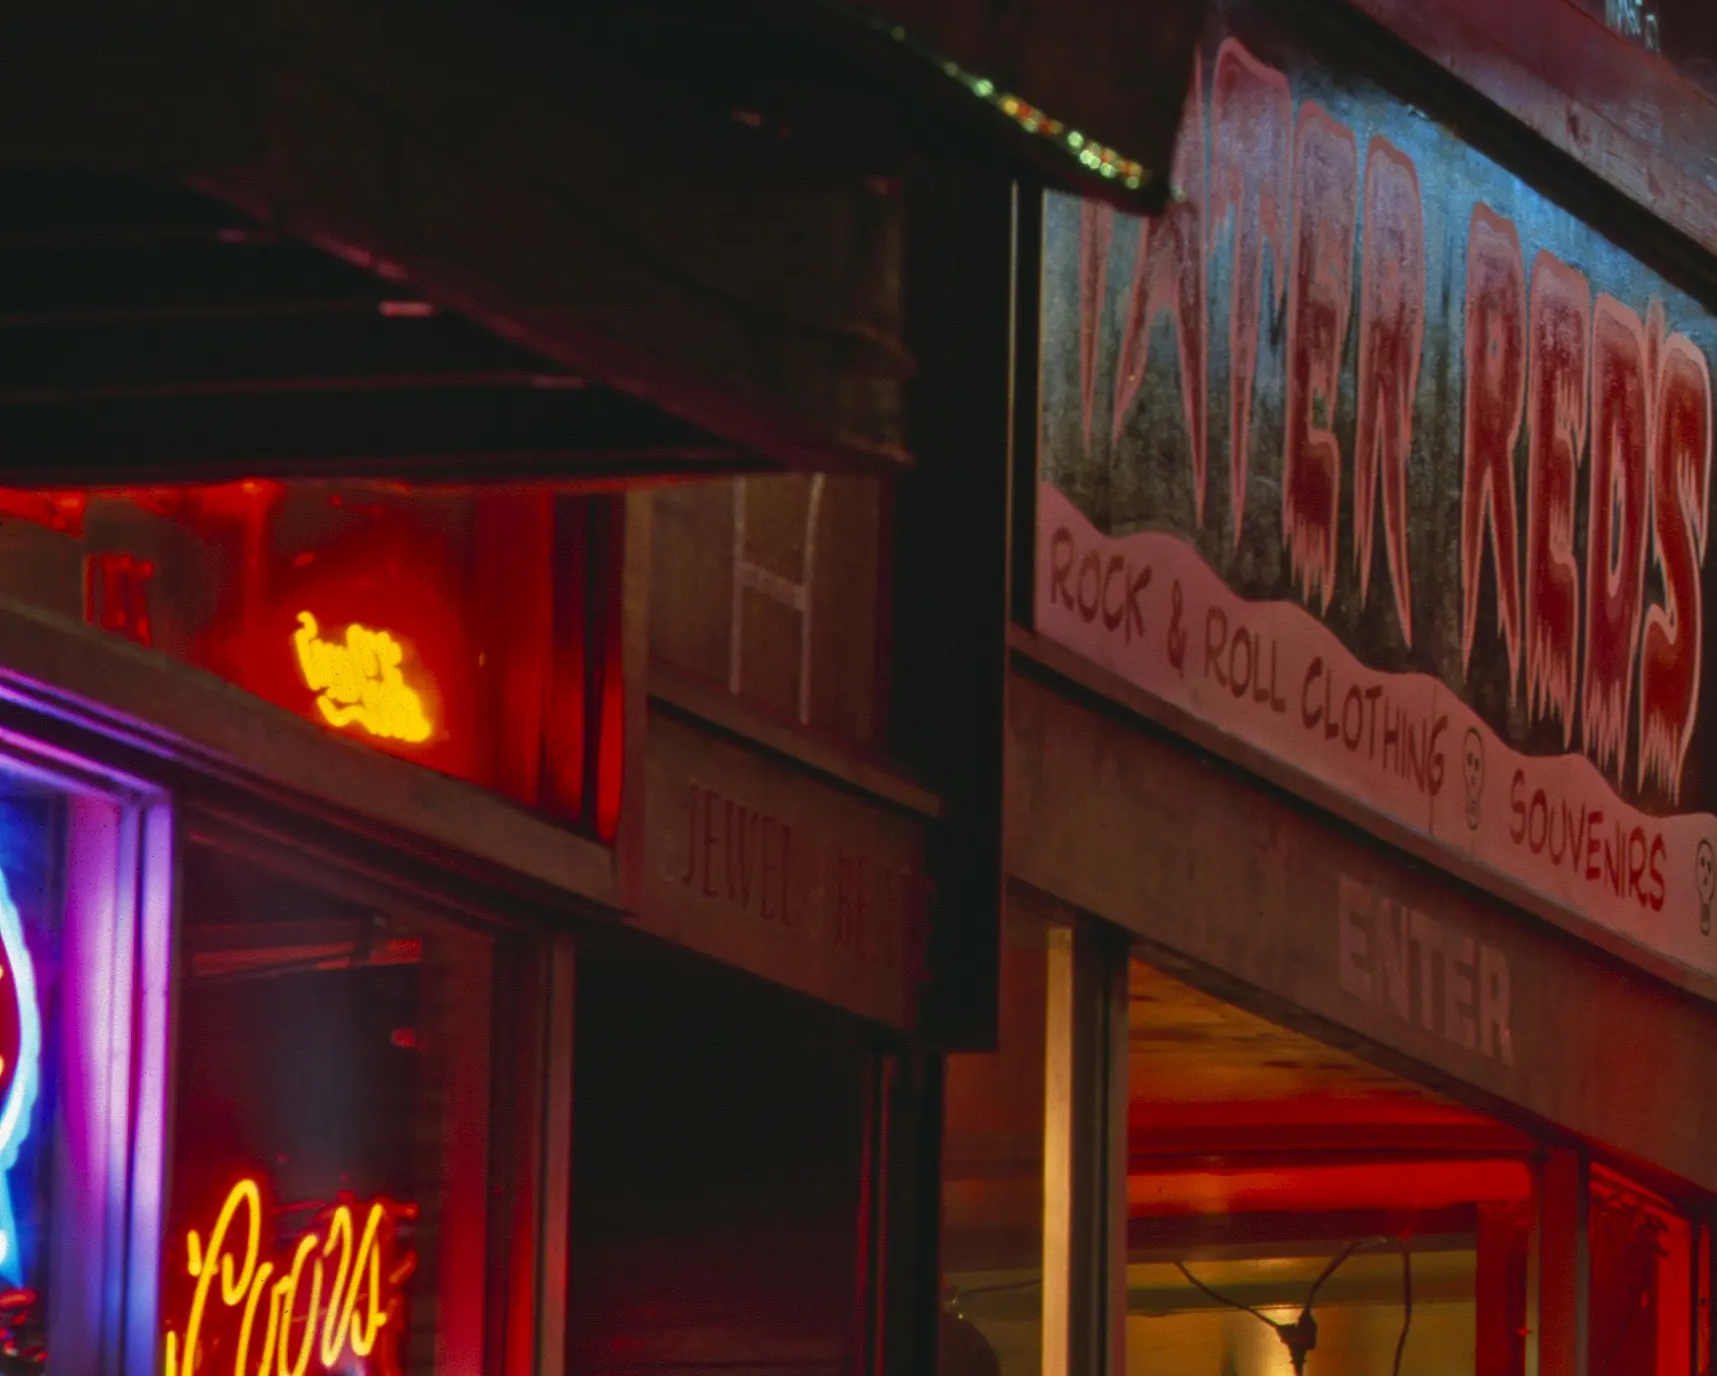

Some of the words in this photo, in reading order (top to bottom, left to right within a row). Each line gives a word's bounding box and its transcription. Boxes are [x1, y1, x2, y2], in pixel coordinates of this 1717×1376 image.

[1051, 526, 1153, 644] ROCK
[1167, 578, 1188, 680] &
[1204, 605, 1287, 714] ROLL
[1302, 655, 1448, 797] CLOTHING
[1509, 767, 1666, 912] SOUVENIRS
[1338, 873, 1515, 1067] ENTER
